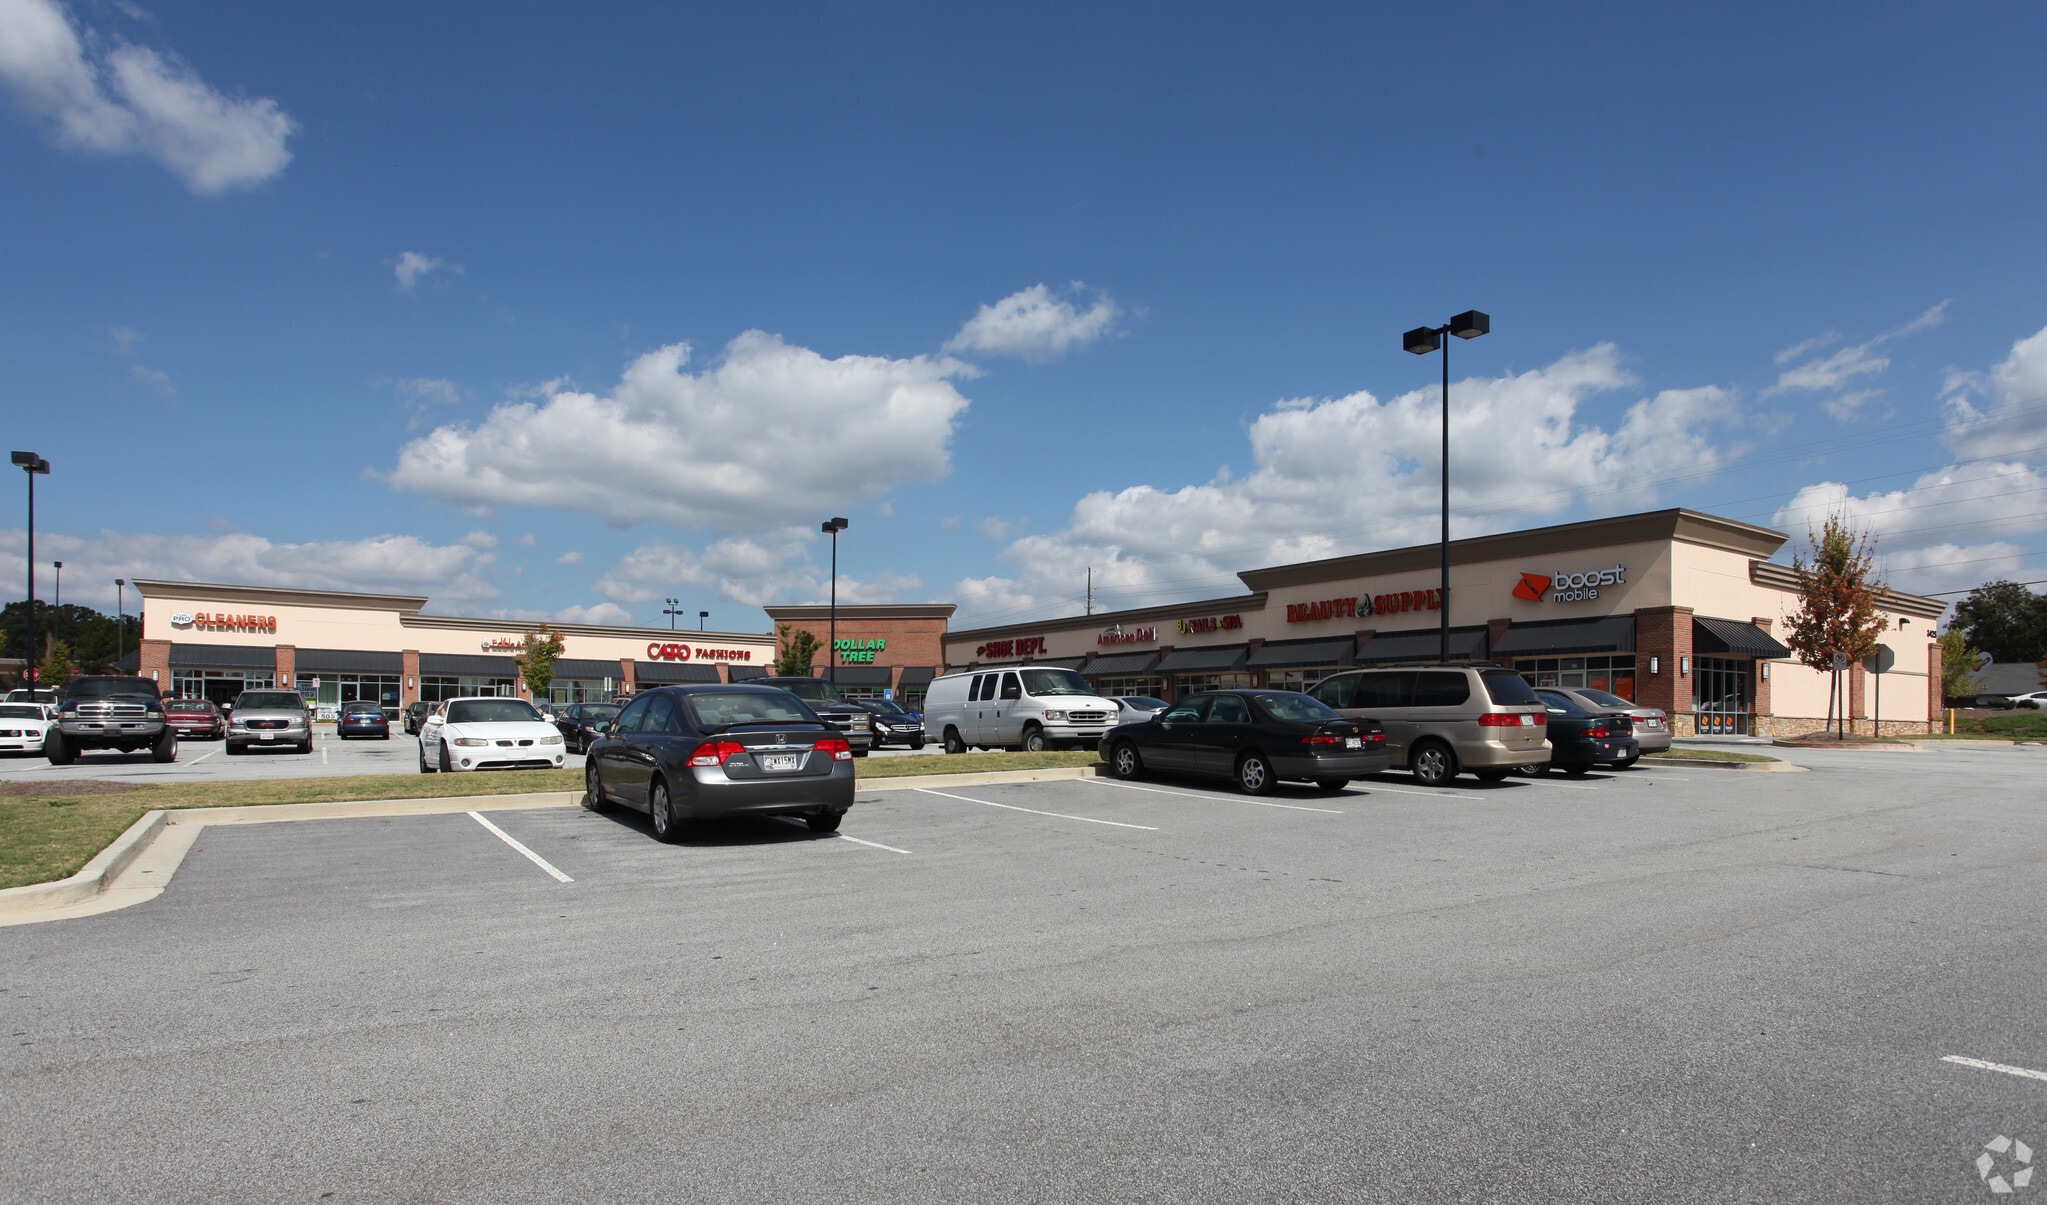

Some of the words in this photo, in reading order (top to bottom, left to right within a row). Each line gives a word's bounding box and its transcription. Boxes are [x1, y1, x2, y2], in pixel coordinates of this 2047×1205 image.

[1555, 564, 1625, 590] boost
[1554, 588, 1598, 602] mobile
[1286, 597, 1357, 623] BEAUTY
[195, 612, 276, 629] CLEANERS
[1176, 619, 1187, 634] BJ
[1188, 617, 1216, 633] NAILS
[1222, 615, 1242, 631] SPA
[834, 639, 886, 650] DOLLAR
[1097, 631, 1136, 645] American
[1136, 626, 1157, 641] Deli
[647, 643, 691, 661] CATO
[695, 648, 751, 660] FASHIONS
[841, 651, 875, 662] TREE
[985, 640, 1013, 658] SHOE
[1015, 637, 1047, 656] DEPT.
